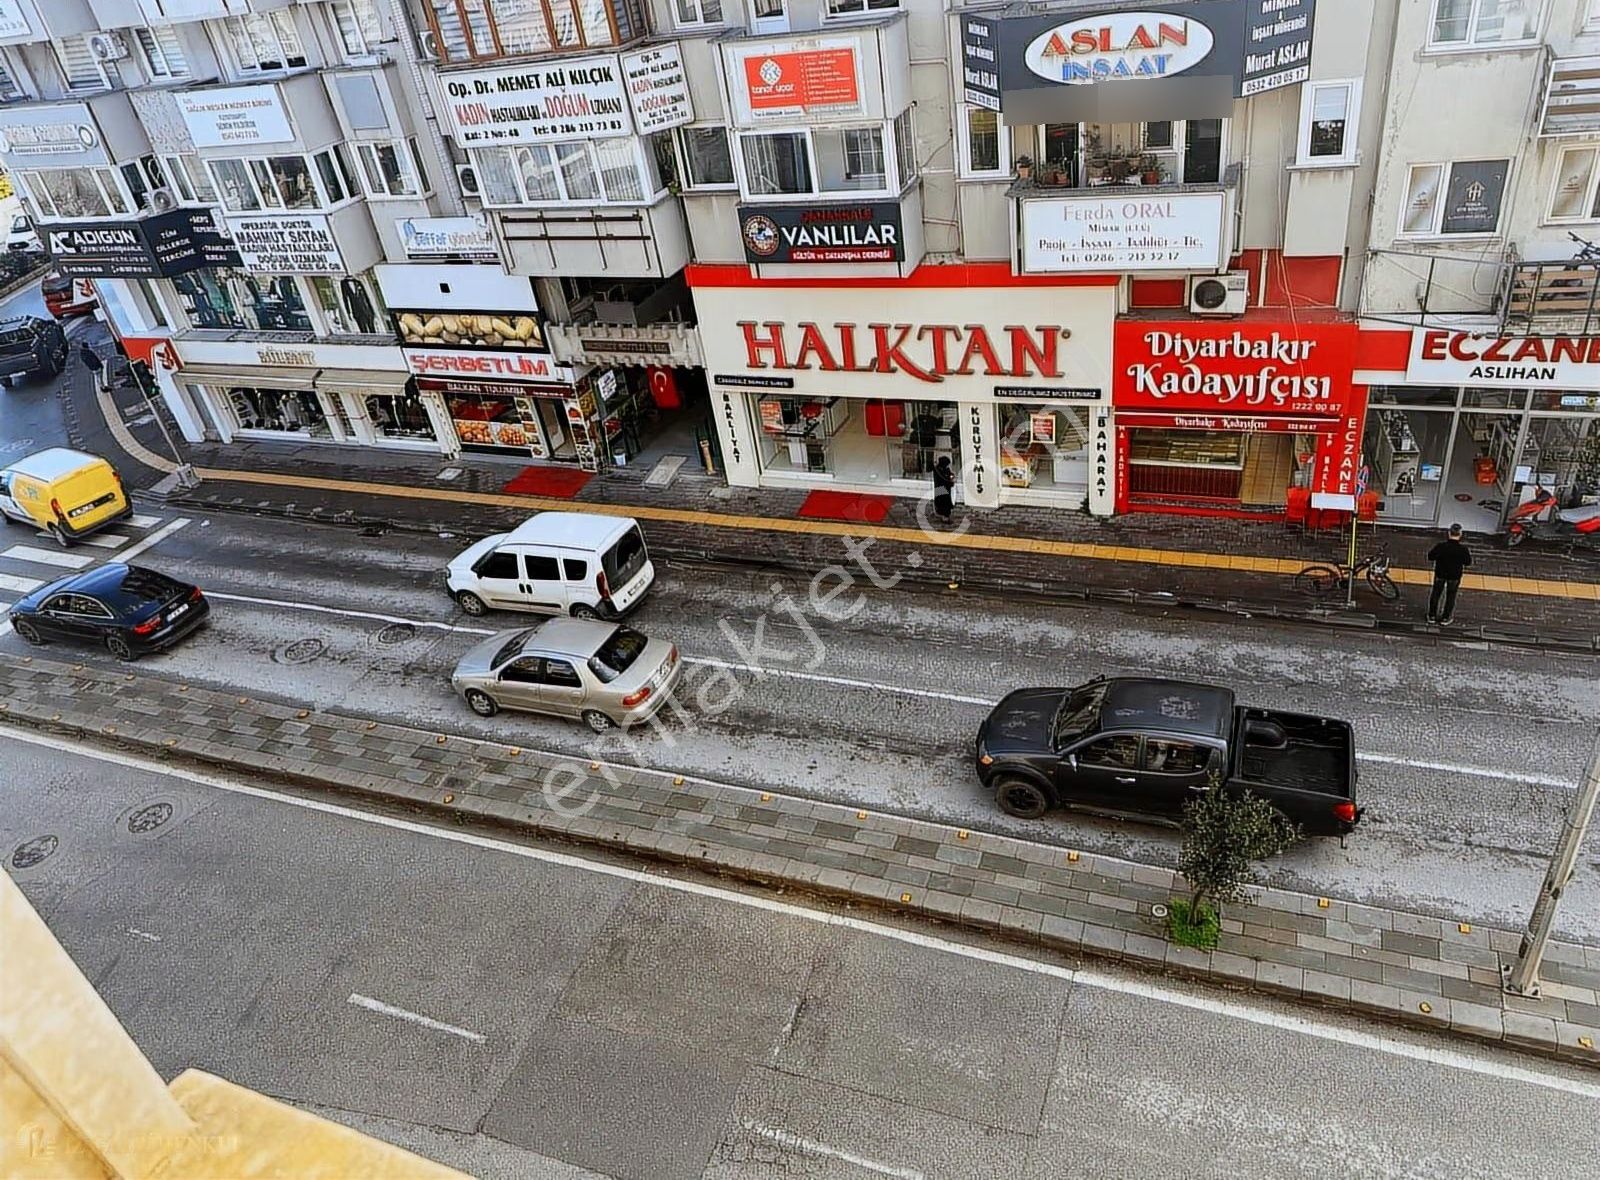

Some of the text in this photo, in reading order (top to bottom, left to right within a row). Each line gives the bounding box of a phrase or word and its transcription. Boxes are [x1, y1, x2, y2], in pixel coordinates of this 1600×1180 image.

[1041, 20, 1188, 57] ASLAN
[1245, 40, 1310, 75] Murat ASLAN
[448, 66, 614, 98] Op. Dr. MEMET ALİ KILÇIK
[1246, 79, 1266, 93] 0532
[455, 102, 492, 126] KADIN
[490, 105, 541, 123] HASTALIKLARI
[544, 88, 591, 119] DOĞUM
[589, 97, 623, 115] UZMANI
[464, 129, 482, 141] Kat:
[484, 131, 489, 139] 2
[550, 124, 557, 133] 0
[560, 123, 577, 133] 286
[579, 122, 594, 131] 213
[597, 121, 607, 130] 73
[1122, 201, 1176, 219] ORAL
[73, 229, 137, 245] ADIGÜN
[235, 230, 328, 243] MAHMUT SATAN
[781, 224, 897, 246] VANLILAR
[240, 243, 335, 253] KADIN HASTALIKLARI
[792, 250, 816, 260] KÜLTÜR
[824, 252, 861, 261] DAYANIŞMA
[861, 250, 891, 259] DERNEĞİ
[1084, 252, 1114, 262] 0286
[257, 253, 328, 263] DOĞUM UZMANI
[736, 321, 1065, 383] HALKTAN
[1144, 331, 1318, 364] Diyarbakır
[410, 354, 549, 376] ŞERBETLİM
[1469, 366, 1556, 380] ASLIHAN
[447, 382, 481, 392] BALKAN
[484, 383, 527, 395] TULUMBA
[1127, 364, 1331, 405] Kadayıfçısı
[1096, 418, 1106, 497] BAHARAT
[1339, 417, 1358, 493] ECZANE
